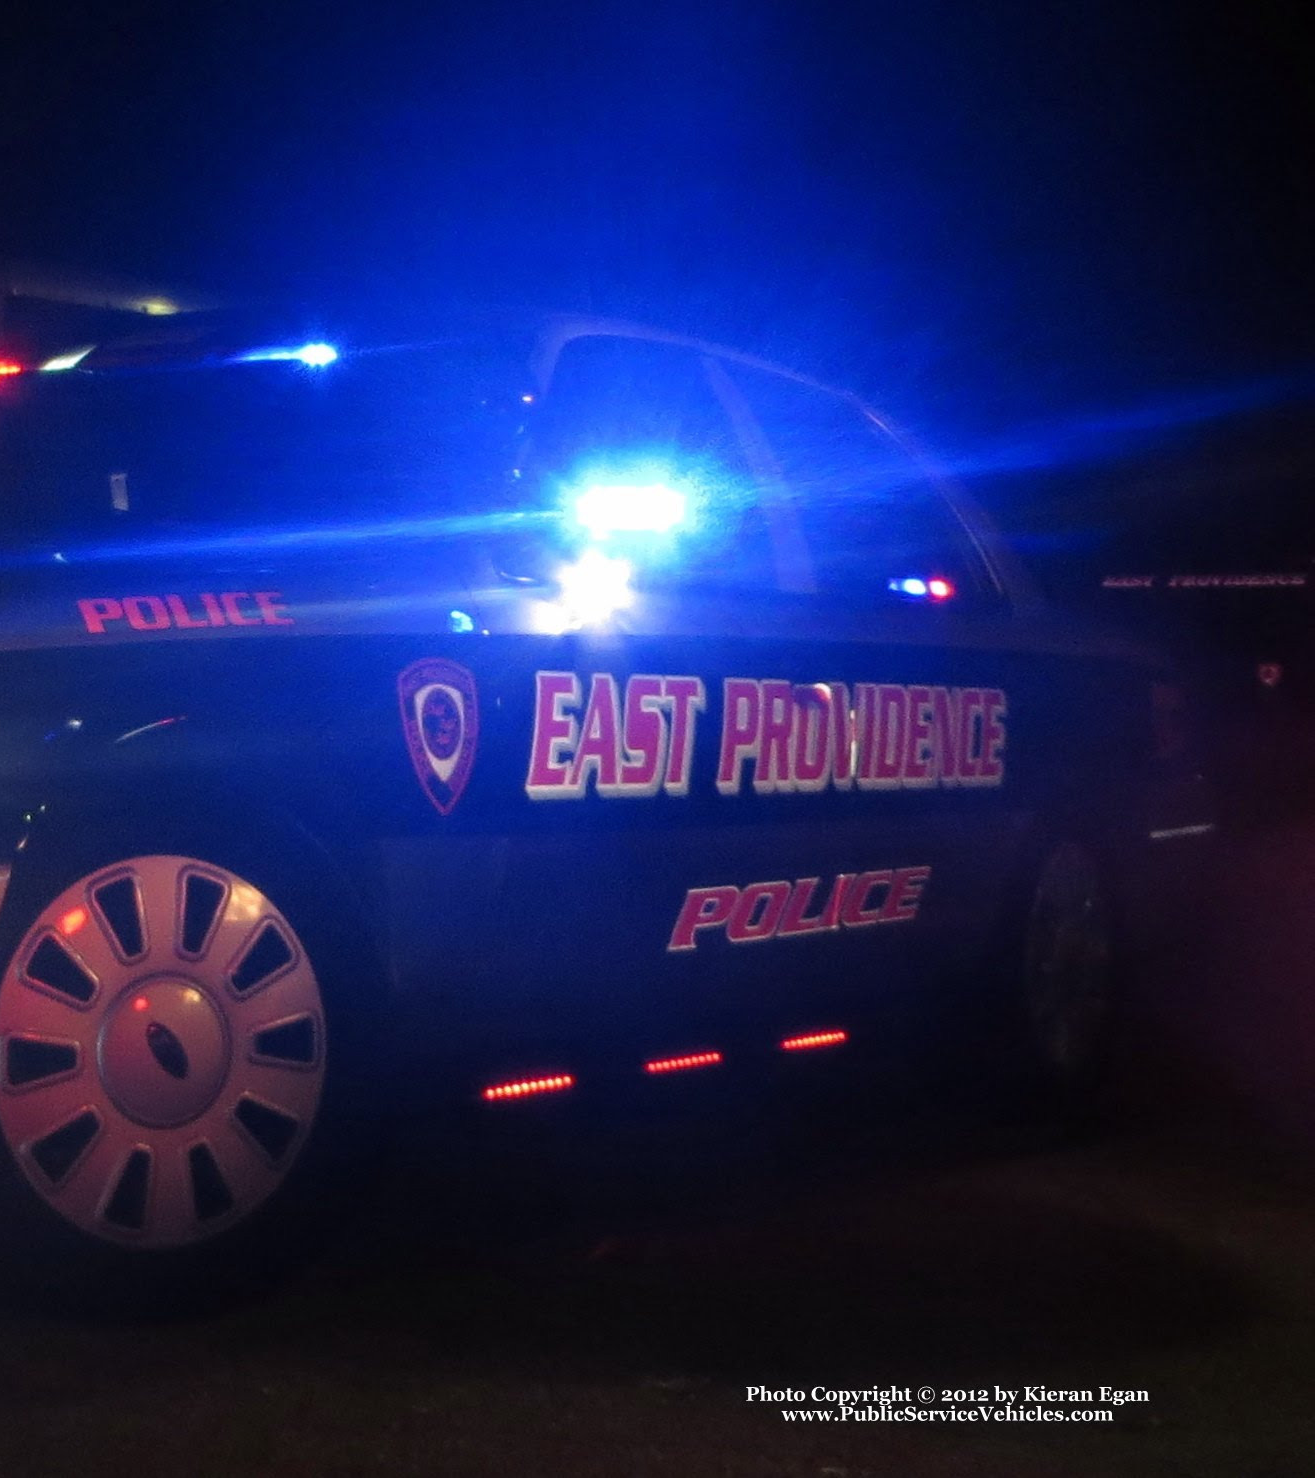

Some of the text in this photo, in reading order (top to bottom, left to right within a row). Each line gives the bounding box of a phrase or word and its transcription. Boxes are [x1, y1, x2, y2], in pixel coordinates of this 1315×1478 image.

[78, 591, 295, 634] POLICE
[525, 669, 1008, 801] EAST PROVIDENCE
[666, 865, 933, 952] POLICE
